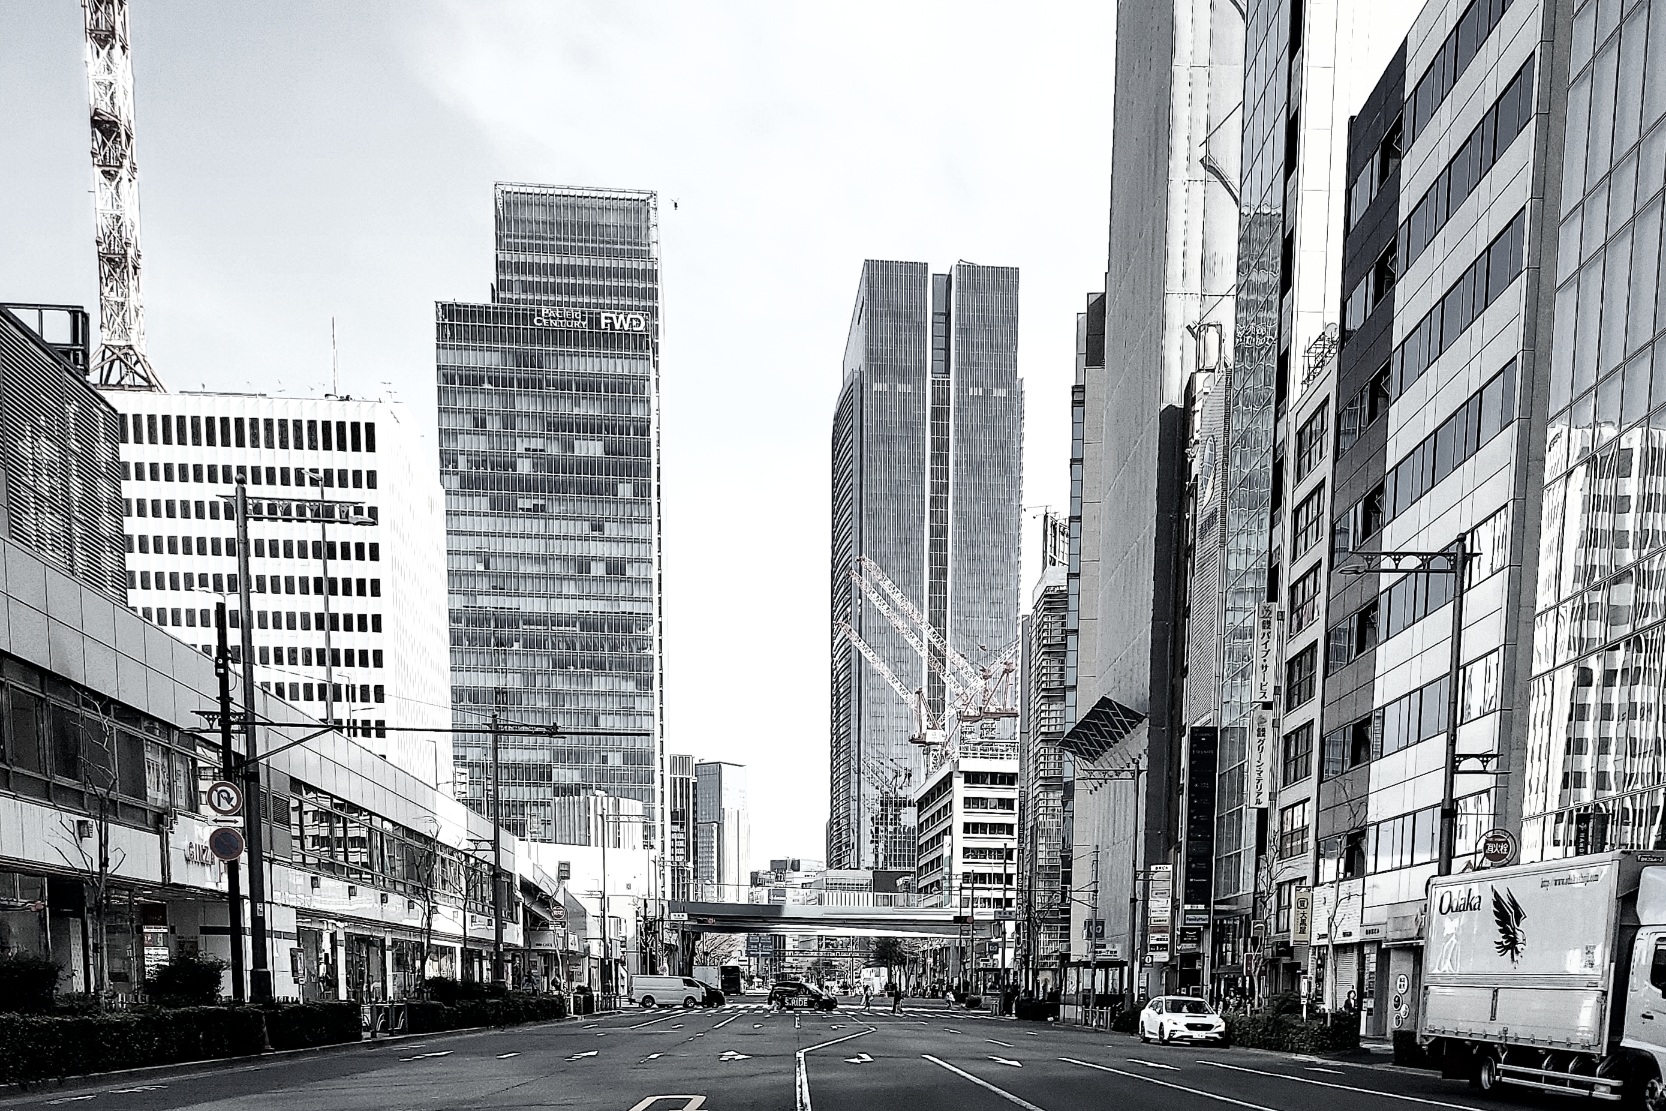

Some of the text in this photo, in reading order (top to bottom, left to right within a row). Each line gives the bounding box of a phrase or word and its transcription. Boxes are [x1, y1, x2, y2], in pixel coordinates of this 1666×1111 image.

[533, 316, 588, 328] CENTURY
[601, 312, 646, 331] FWD
[1484, 843, 1509, 855] 消火栓
[1439, 888, 1482, 916] Odaka
[784, 996, 809, 1007] S.RIDE
